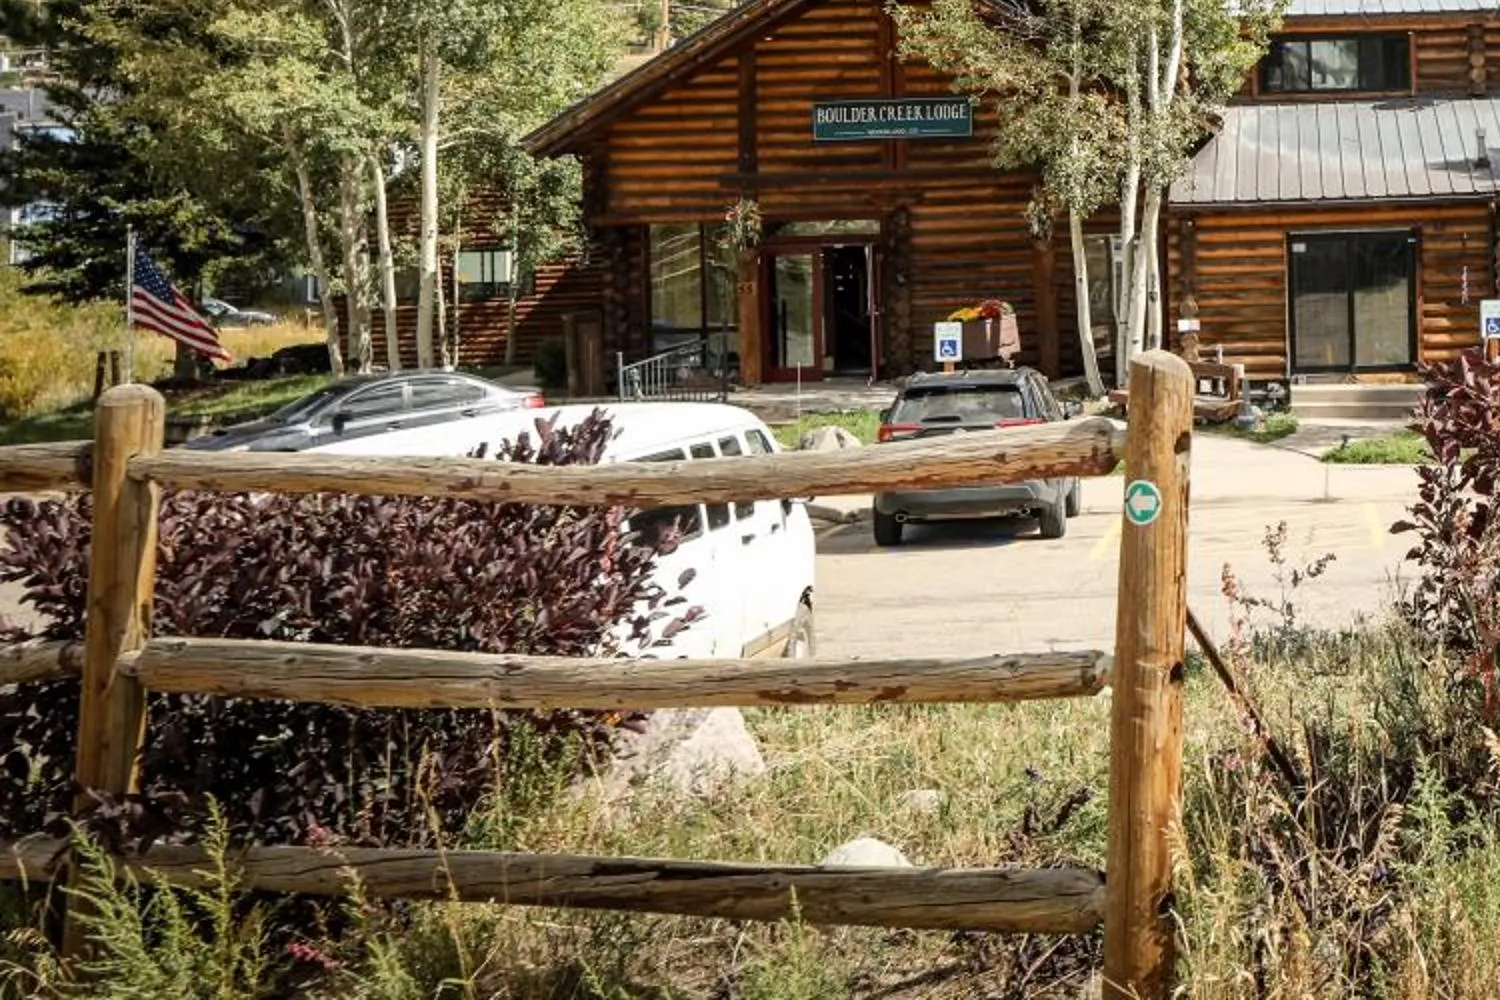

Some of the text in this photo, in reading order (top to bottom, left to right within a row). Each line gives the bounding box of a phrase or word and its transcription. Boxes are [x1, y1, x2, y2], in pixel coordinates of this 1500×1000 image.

[817, 104, 967, 123] BOULDER CREEK LODGE
